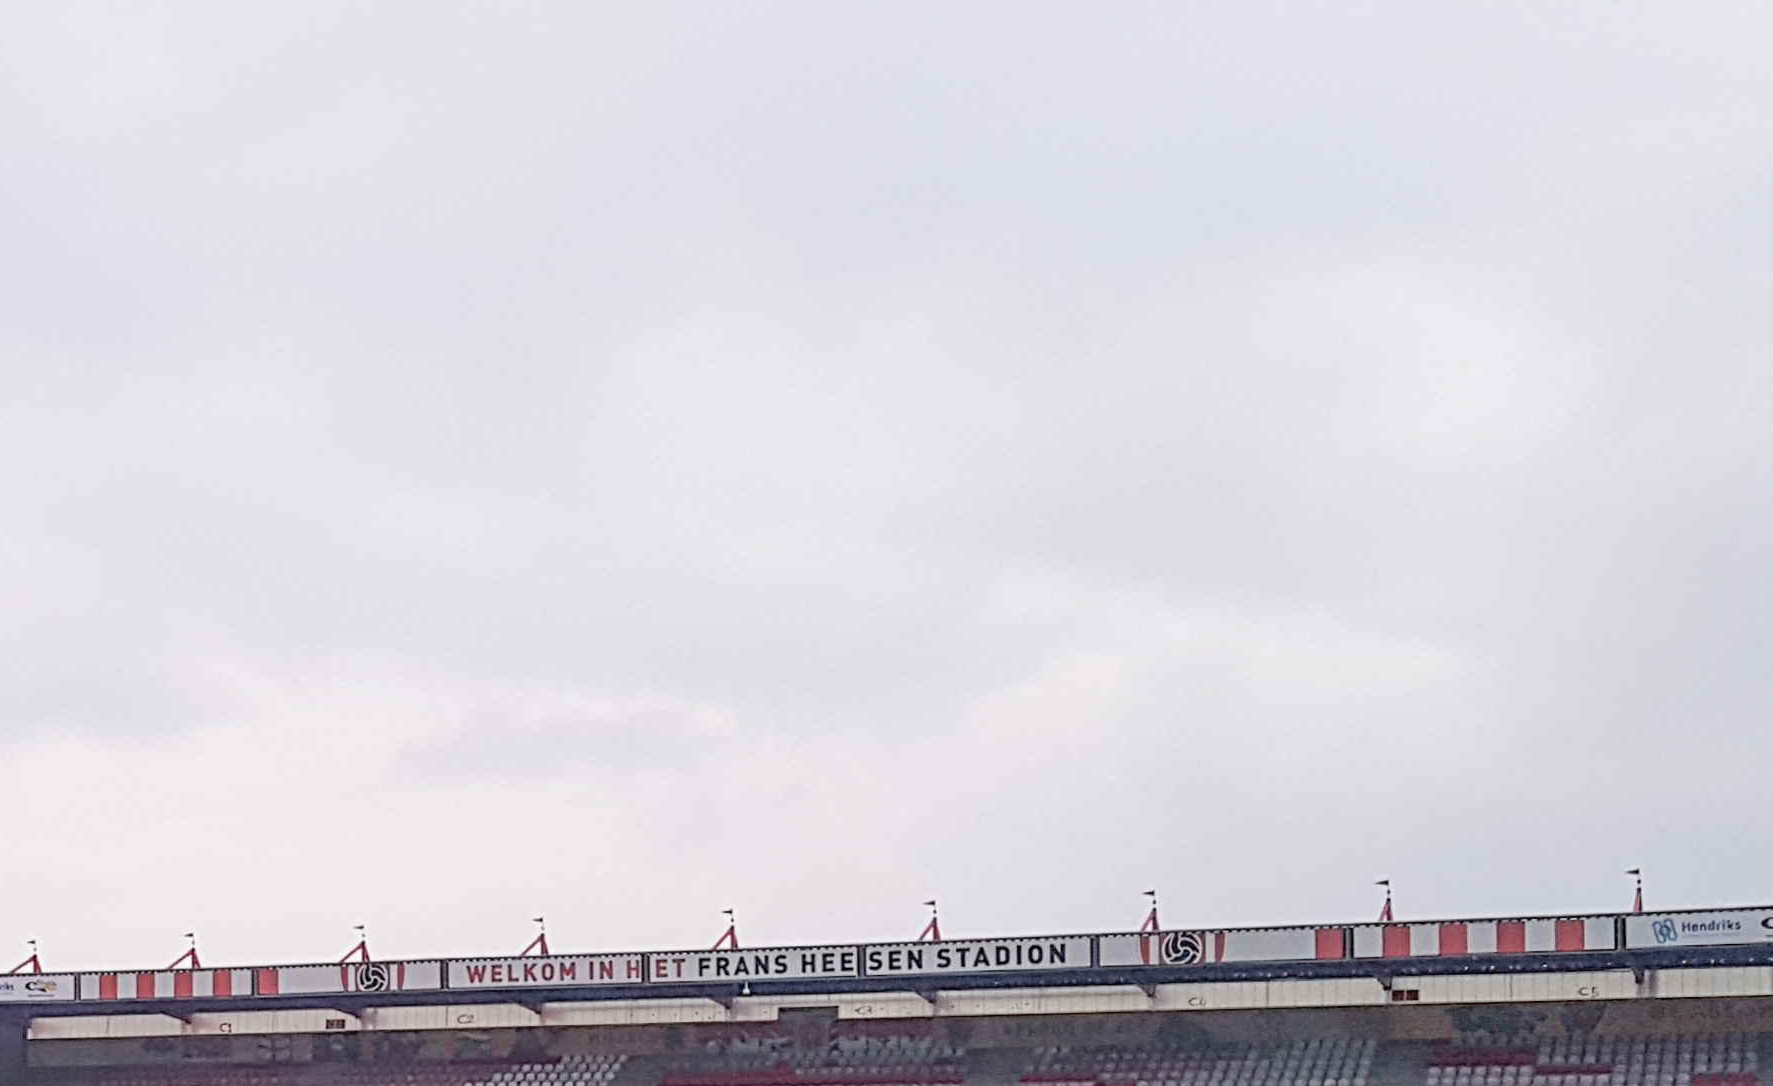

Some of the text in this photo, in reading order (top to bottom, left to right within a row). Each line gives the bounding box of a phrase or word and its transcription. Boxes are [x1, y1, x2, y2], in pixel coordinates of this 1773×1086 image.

[1681, 919, 1742, 932] Hendriks
[466, 961, 577, 984] WELKOM
[589, 960, 614, 981] IN
[697, 954, 788, 977] FRANS
[936, 943, 1067, 968] STADION
